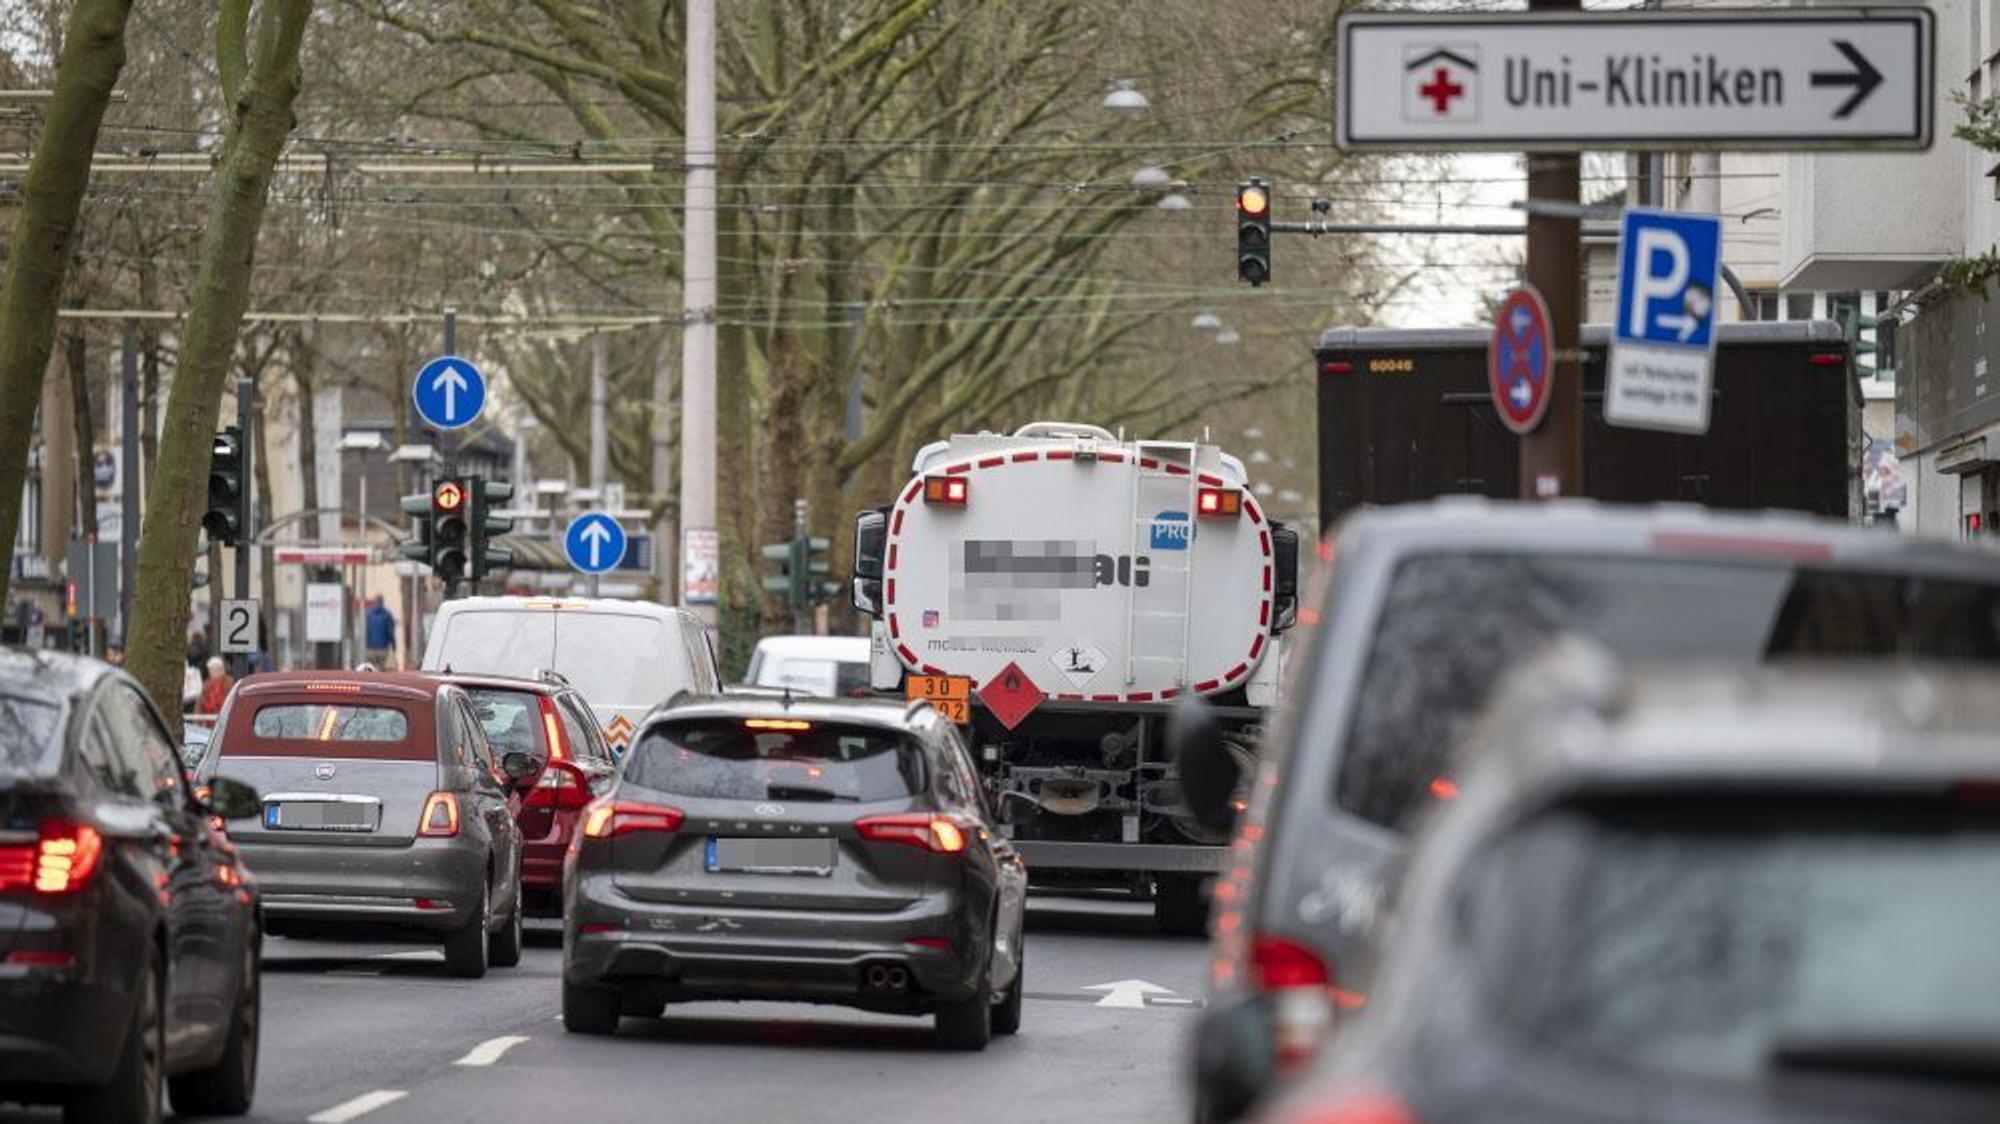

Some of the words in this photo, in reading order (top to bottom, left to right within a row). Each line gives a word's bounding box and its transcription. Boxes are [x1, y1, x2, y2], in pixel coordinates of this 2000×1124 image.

[1504, 55, 1785, 106] Uni-Kliniken
[1629, 226, 1691, 338] P
[228, 607, 249, 645] 2
[924, 678, 950, 696] 30
